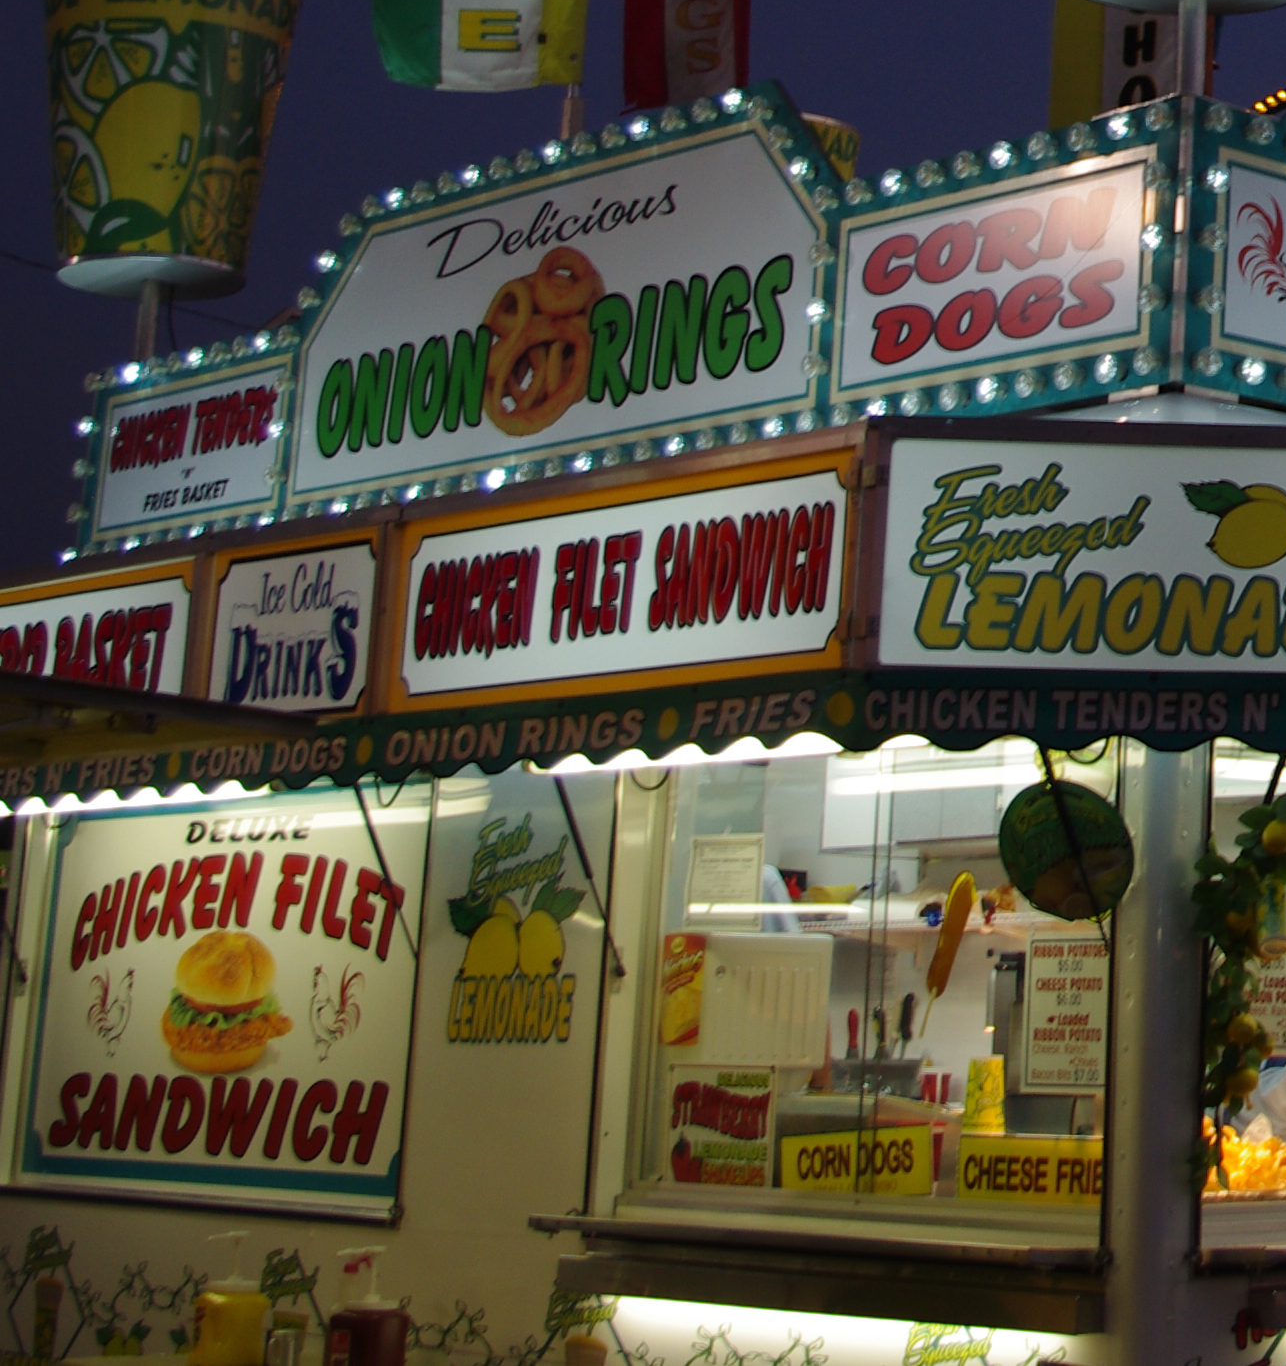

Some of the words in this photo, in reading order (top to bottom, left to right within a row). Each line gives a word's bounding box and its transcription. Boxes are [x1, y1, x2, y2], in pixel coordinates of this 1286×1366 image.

[427, 183, 678, 280] Delicious
[862, 187, 1118, 296] CORN
[870, 257, 1125, 365] DOGS
[316, 323, 492, 459] ONION
[588, 254, 794, 407] RINGS
[110, 402, 192, 474] CHICKEN
[191, 384, 279, 457] TENDERS
[142, 487, 181, 512] FRIES
[181, 478, 230, 505] BASKET
[909, 494, 1152, 583] Squeezed
[923, 462, 1070, 529] Fresh
[258, 572, 287, 617] Ice
[290, 559, 336, 615] Cold
[413, 545, 541, 661] CHICKEN
[550, 529, 644, 644] FILET
[648, 500, 836, 632] SANDWICH
[223, 601, 359, 704] DRINKS
[76, 753, 159, 790] FRIES
[189, 743, 262, 780] CORN
[269, 735, 348, 773] DOGS
[384, 719, 507, 767] ONION
[516, 708, 648, 755] RINGS
[688, 689, 818, 740] FRIES
[862, 688, 1037, 732] CHICKEN
[1051, 691, 1230, 733] TENDERS
[185, 814, 312, 845] DELUXE
[70, 850, 264, 972] CHICKEN
[272, 853, 405, 962] FILET
[447, 972, 577, 1045] LEMONADE
[48, 1071, 390, 1166] SANDWICH
[797, 1143, 850, 1181] CORN
[857, 1137, 914, 1177] DOGS
[963, 1153, 1049, 1194] CHEESE
